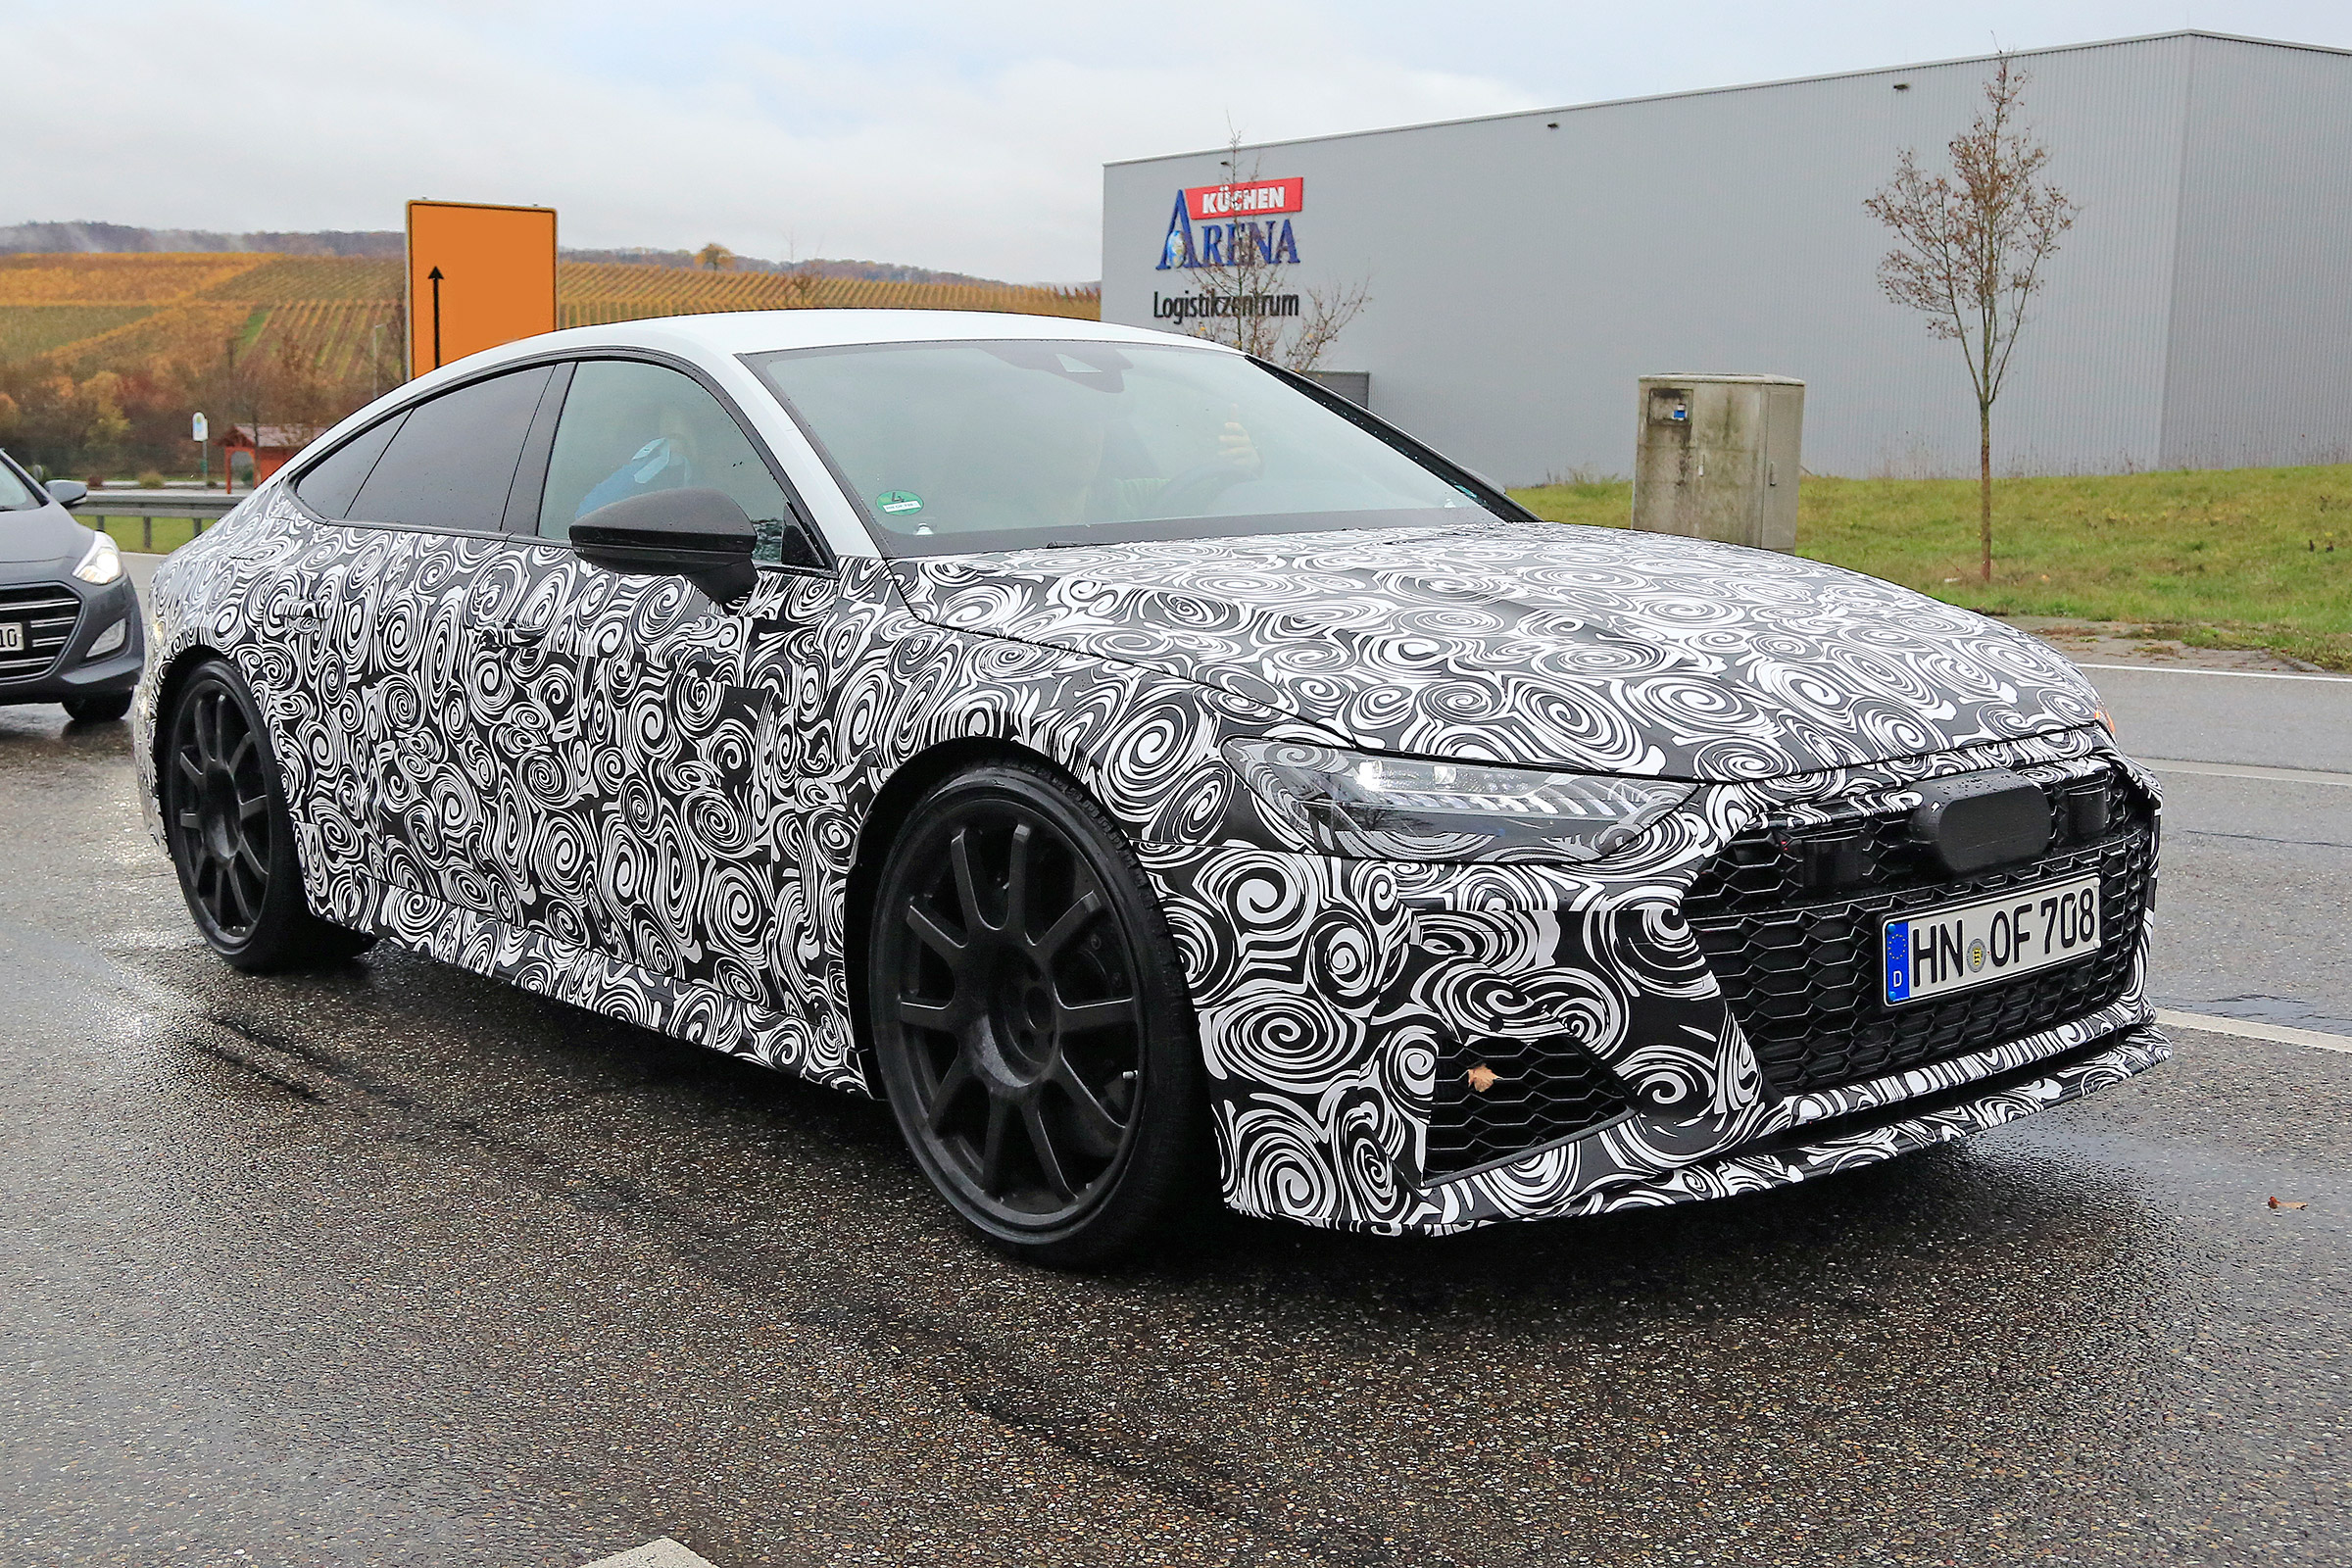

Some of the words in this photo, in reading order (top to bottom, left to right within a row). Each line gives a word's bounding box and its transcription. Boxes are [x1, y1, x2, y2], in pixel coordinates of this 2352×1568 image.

[1201, 185, 1286, 215] KÜCHEN
[1154, 189, 1301, 270] ARENA
[1152, 290, 1299, 325] Logistikzentrum
[1912, 918, 1965, 988] HN
[1989, 903, 2034, 968] OF
[2040, 887, 2095, 956] 708
[1892, 969, 1902, 989] D
